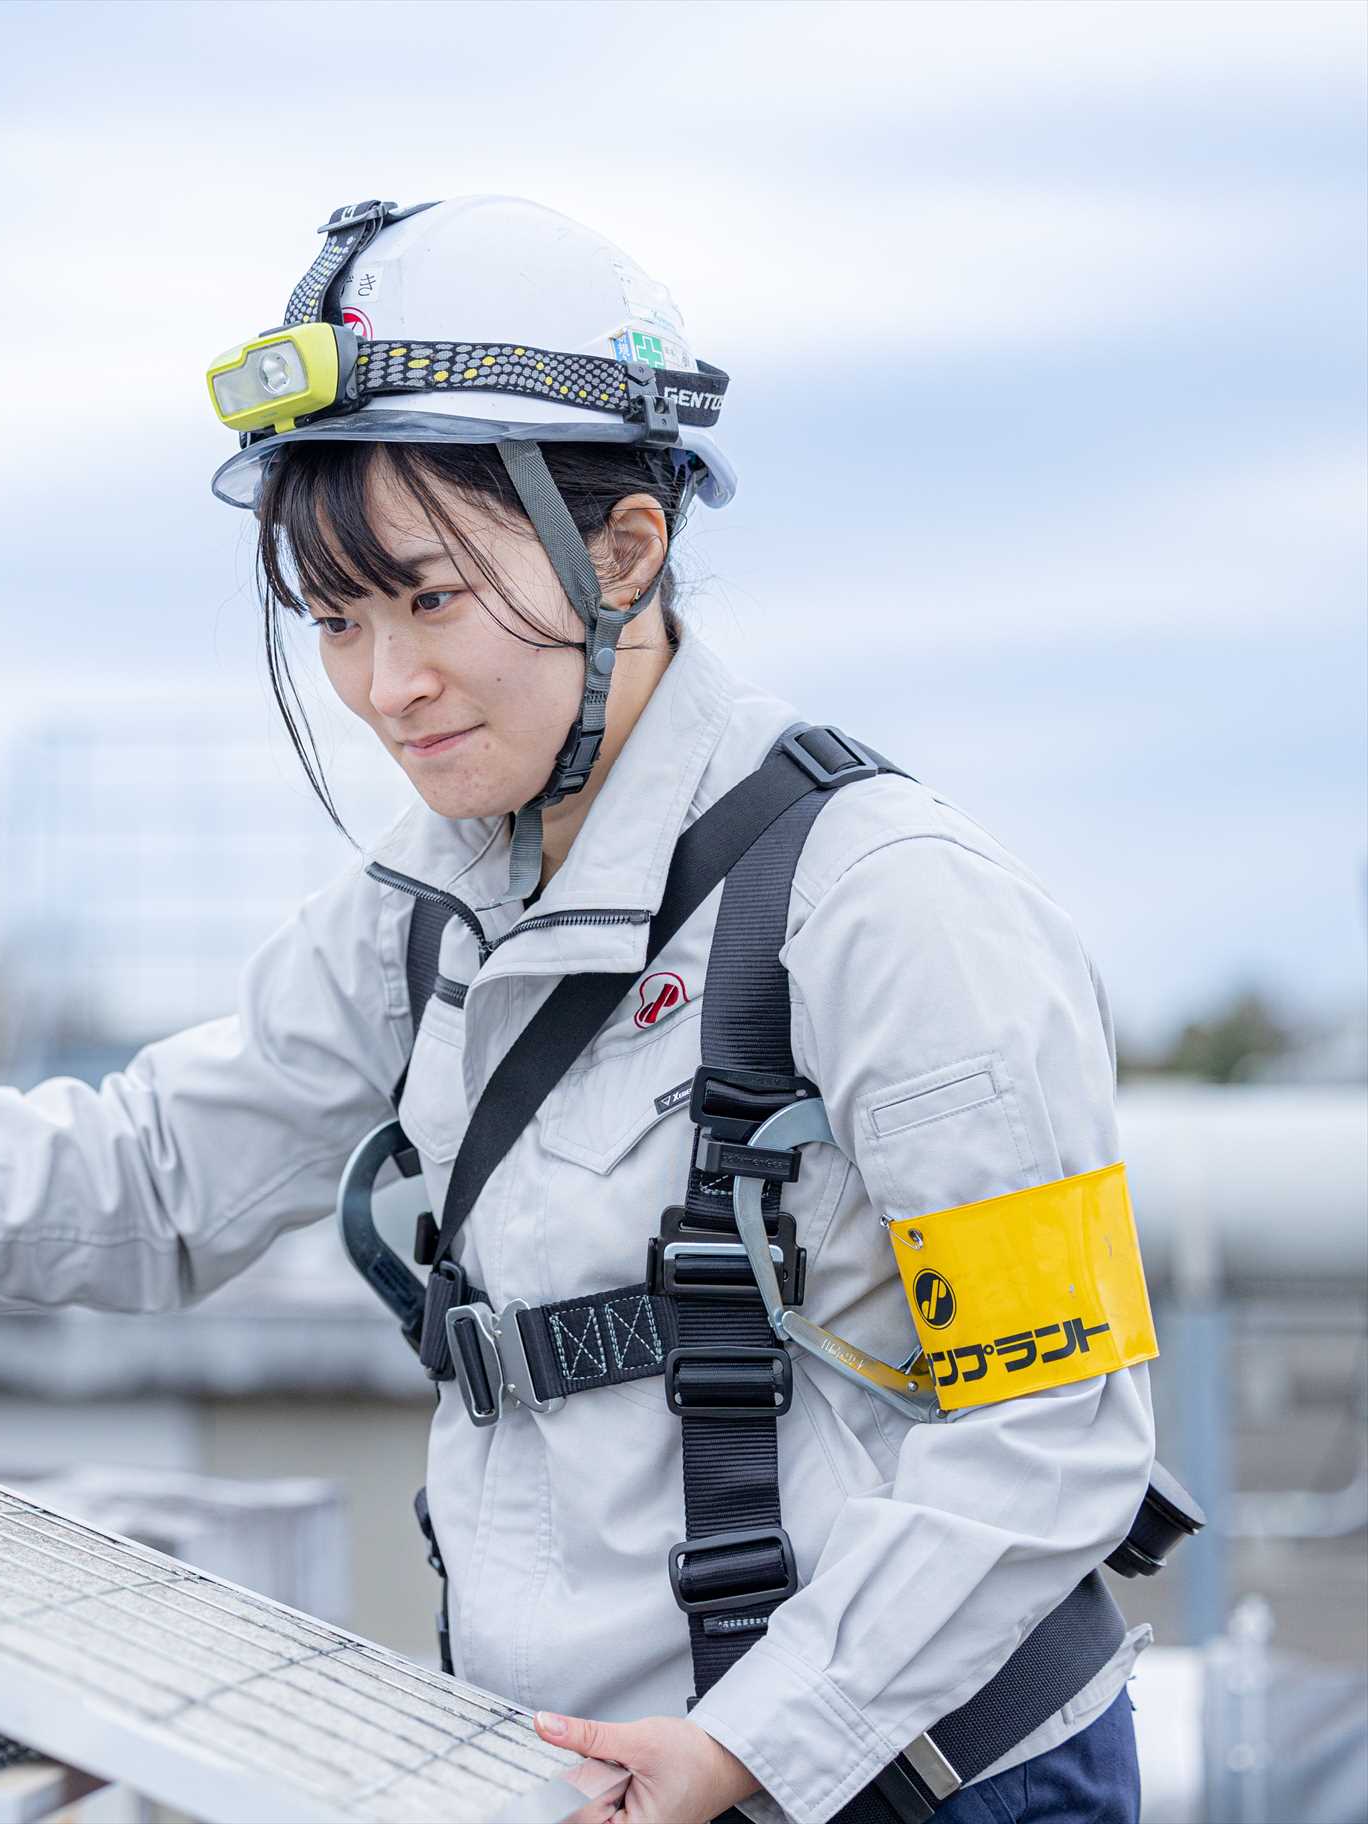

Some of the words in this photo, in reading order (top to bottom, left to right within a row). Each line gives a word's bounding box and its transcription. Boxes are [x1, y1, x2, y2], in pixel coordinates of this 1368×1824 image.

[664, 386, 726, 411] GENTO
[927, 1317, 1111, 1388] ンプラント
